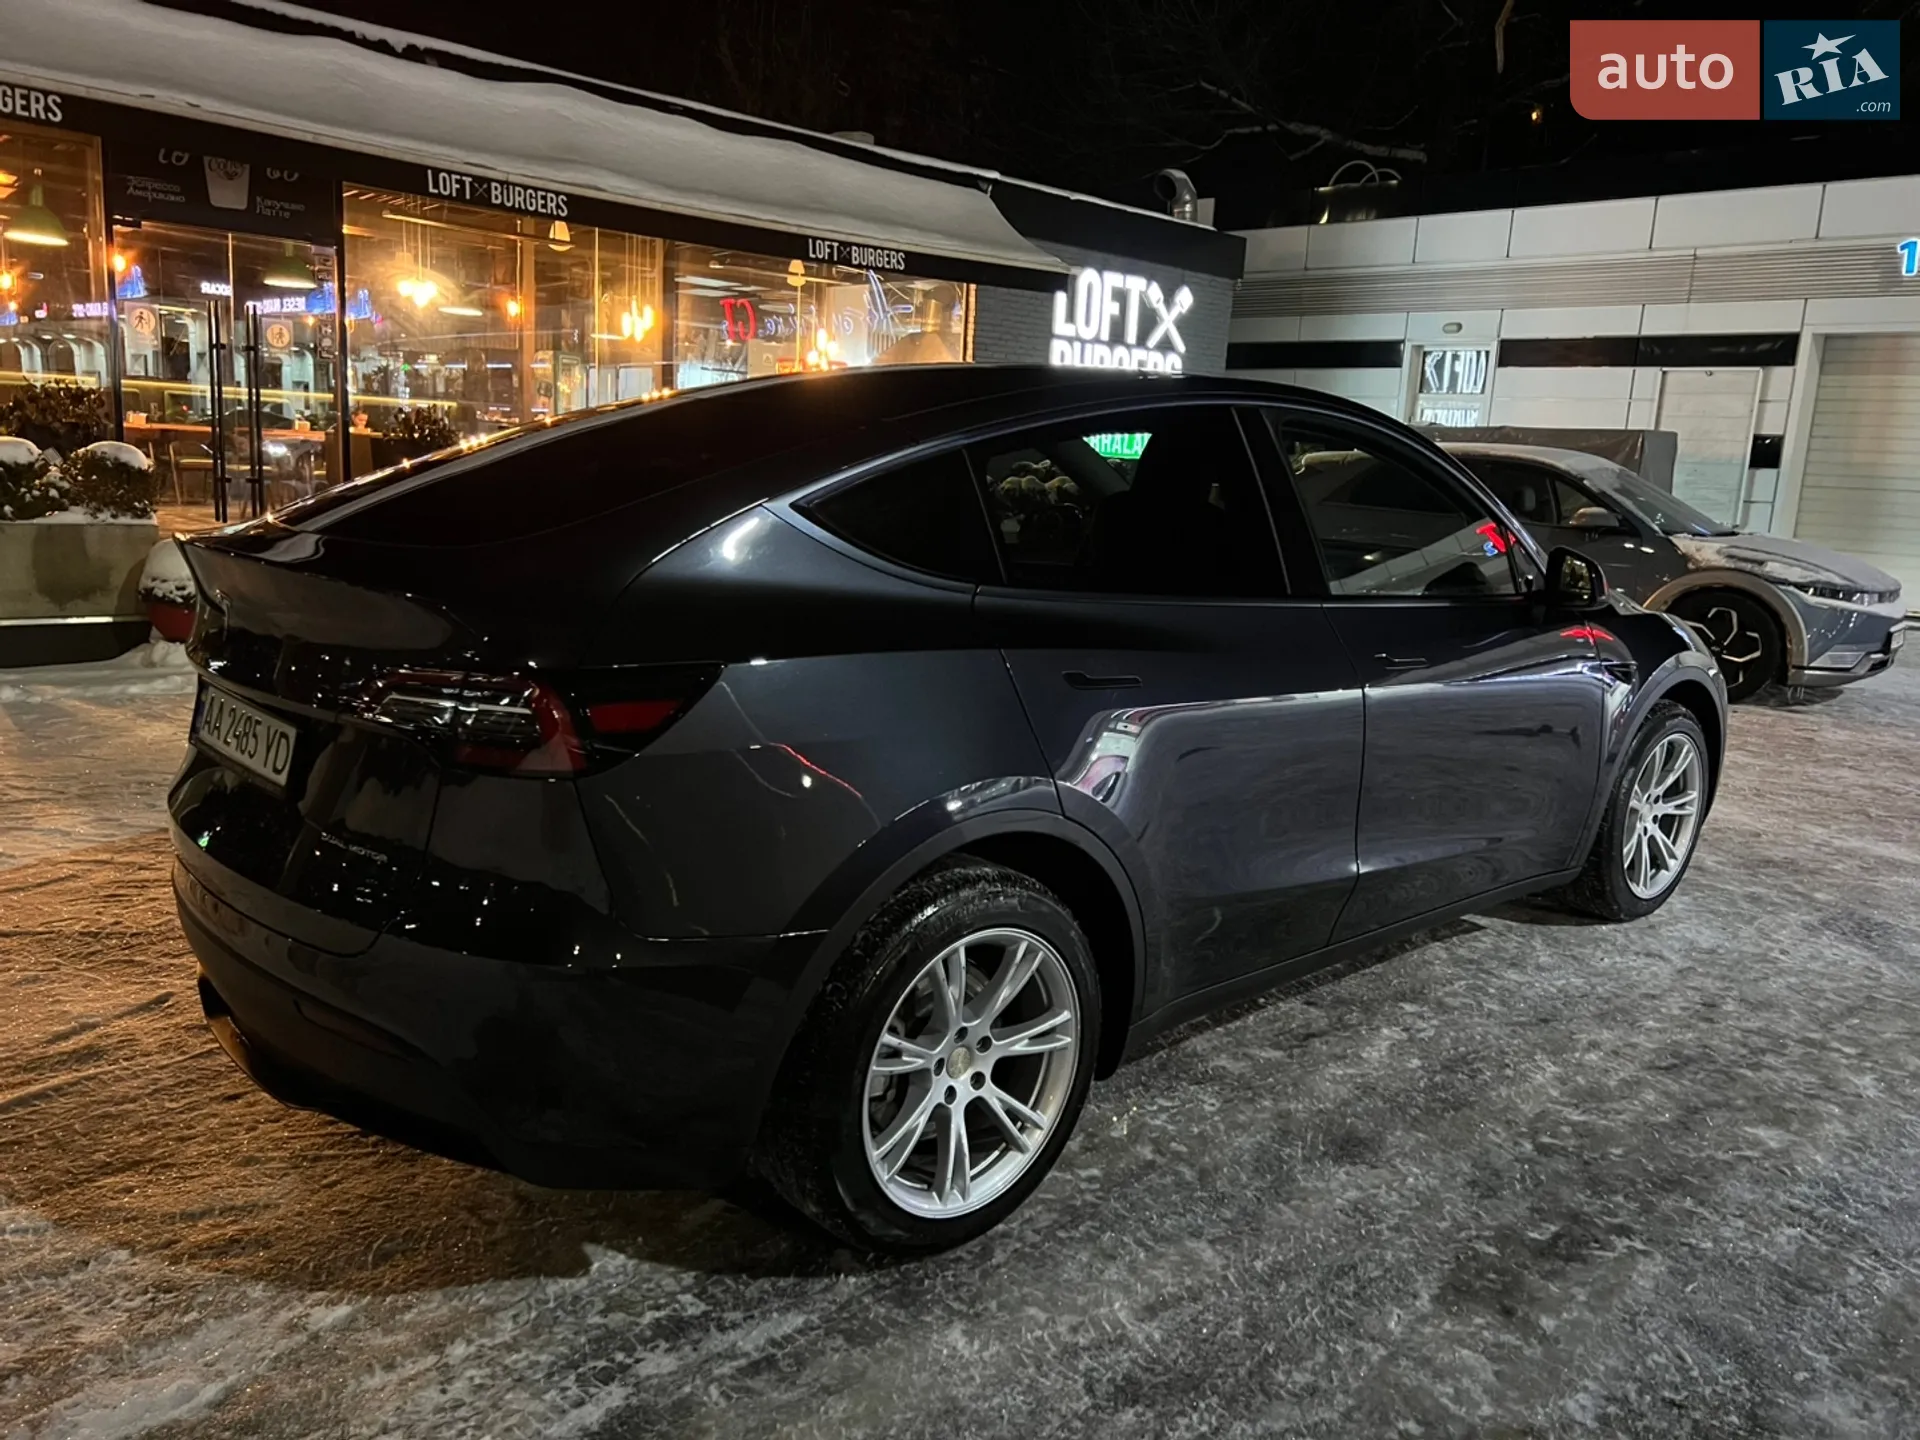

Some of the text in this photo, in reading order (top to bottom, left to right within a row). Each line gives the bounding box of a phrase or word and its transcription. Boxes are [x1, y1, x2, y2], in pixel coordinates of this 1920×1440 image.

[427, 169, 568, 218] LOFT BURGERS
[808, 238, 905, 271] LOFT BURGERS
[1052, 266, 1148, 345] LOFT
[202, 692, 224, 741] AA
[223, 705, 262, 760] 2485
[264, 725, 290, 775] YD
[349, 844, 388, 865] MOTOR
